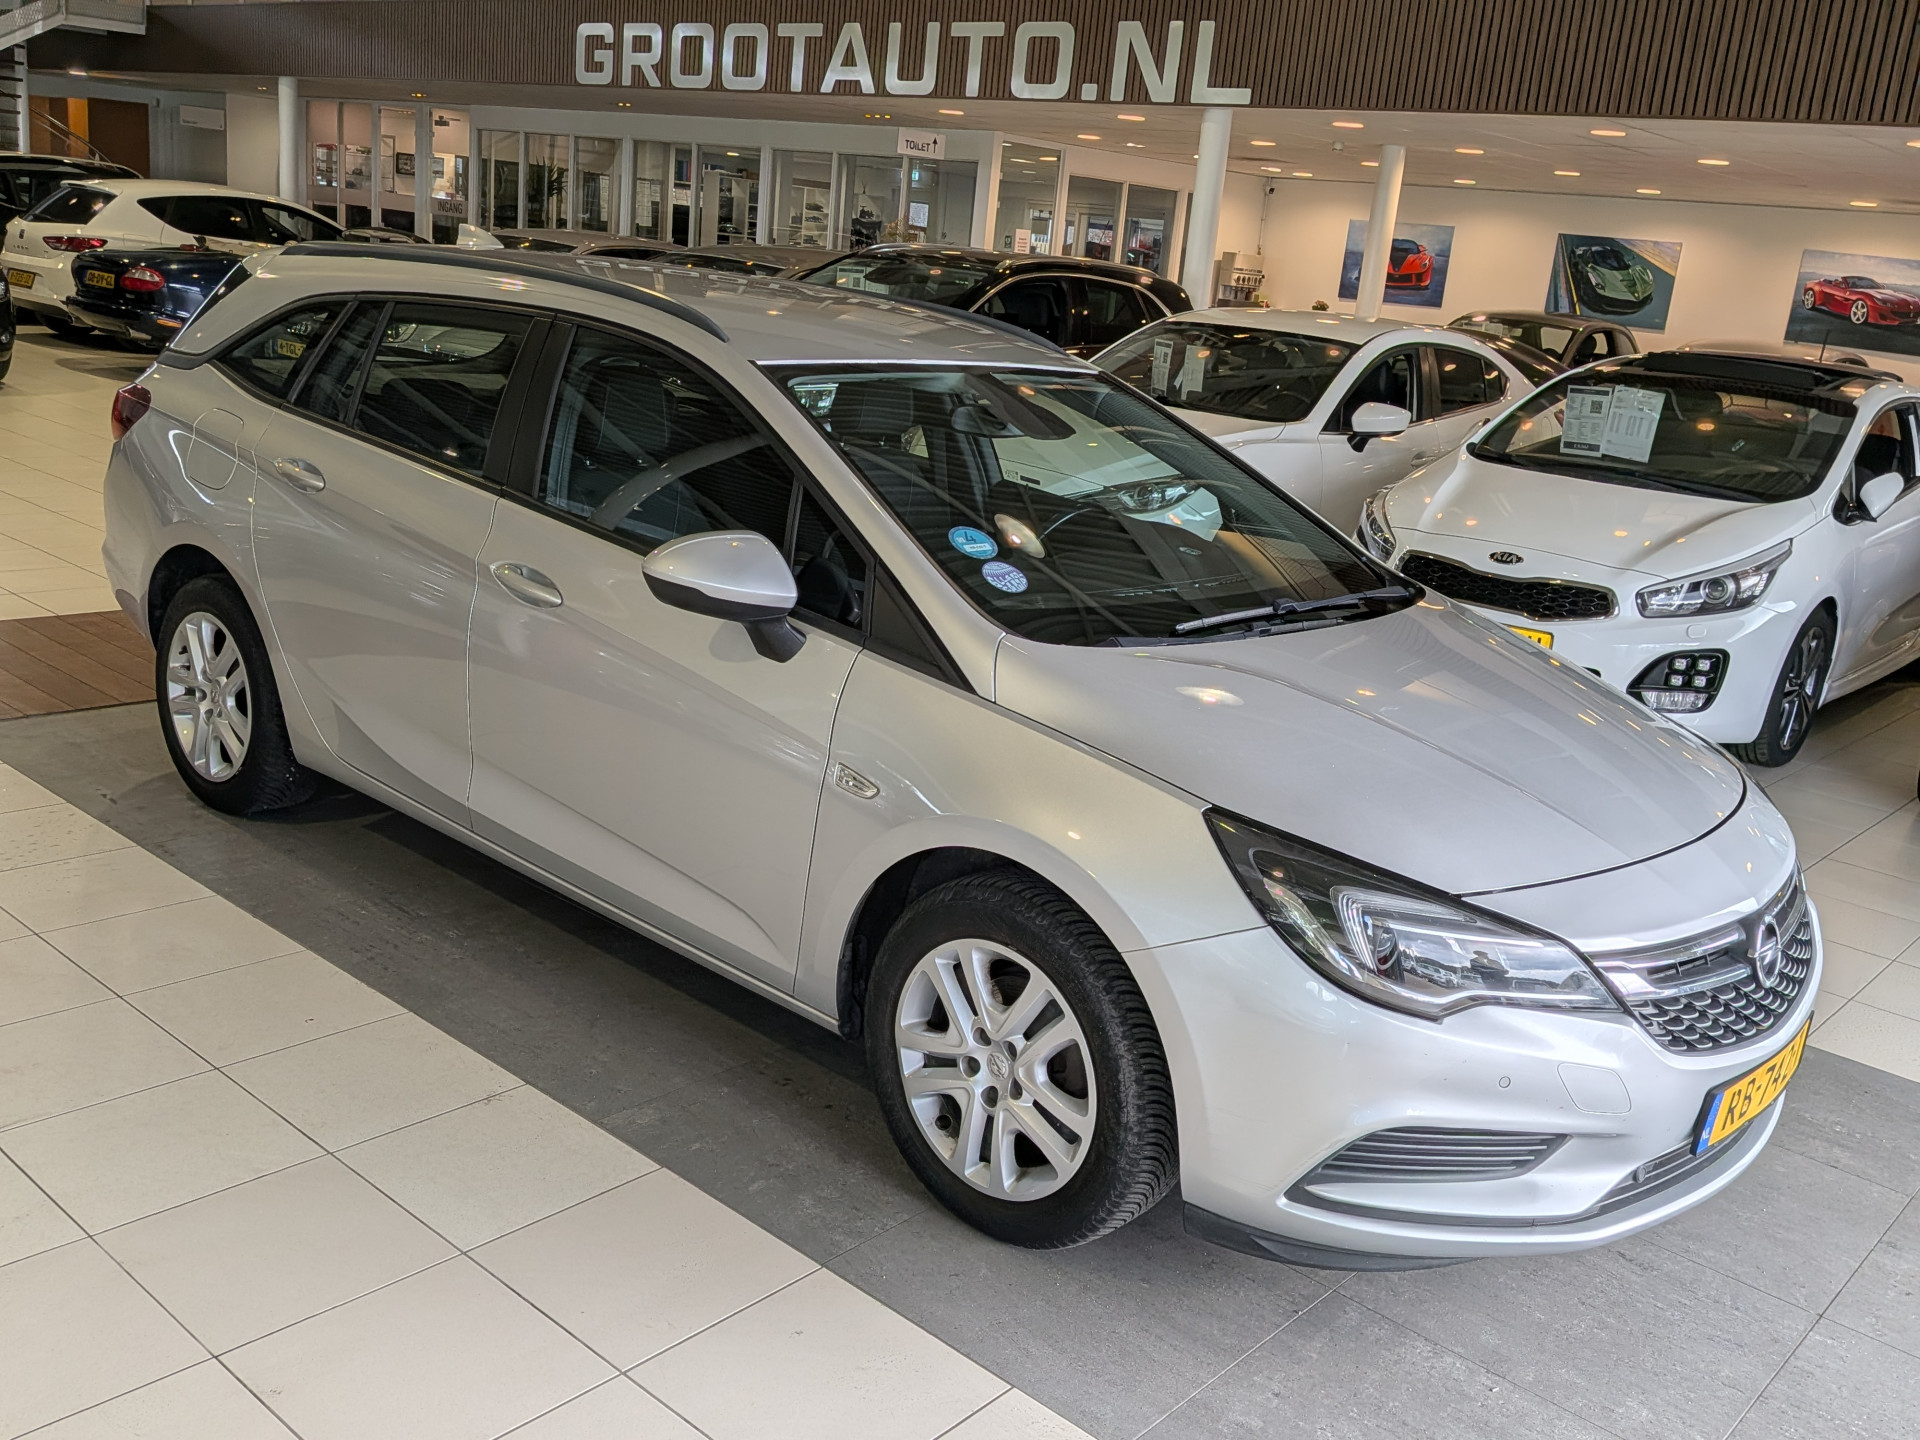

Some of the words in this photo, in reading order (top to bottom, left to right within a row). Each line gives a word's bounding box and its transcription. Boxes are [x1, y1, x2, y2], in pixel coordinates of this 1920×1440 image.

[576, 20, 1251, 105] GROOTAUTO.NL
[904, 138, 931, 152] TOILET
[437, 200, 463, 214] INGANG
[1493, 552, 1517, 563] KIA
